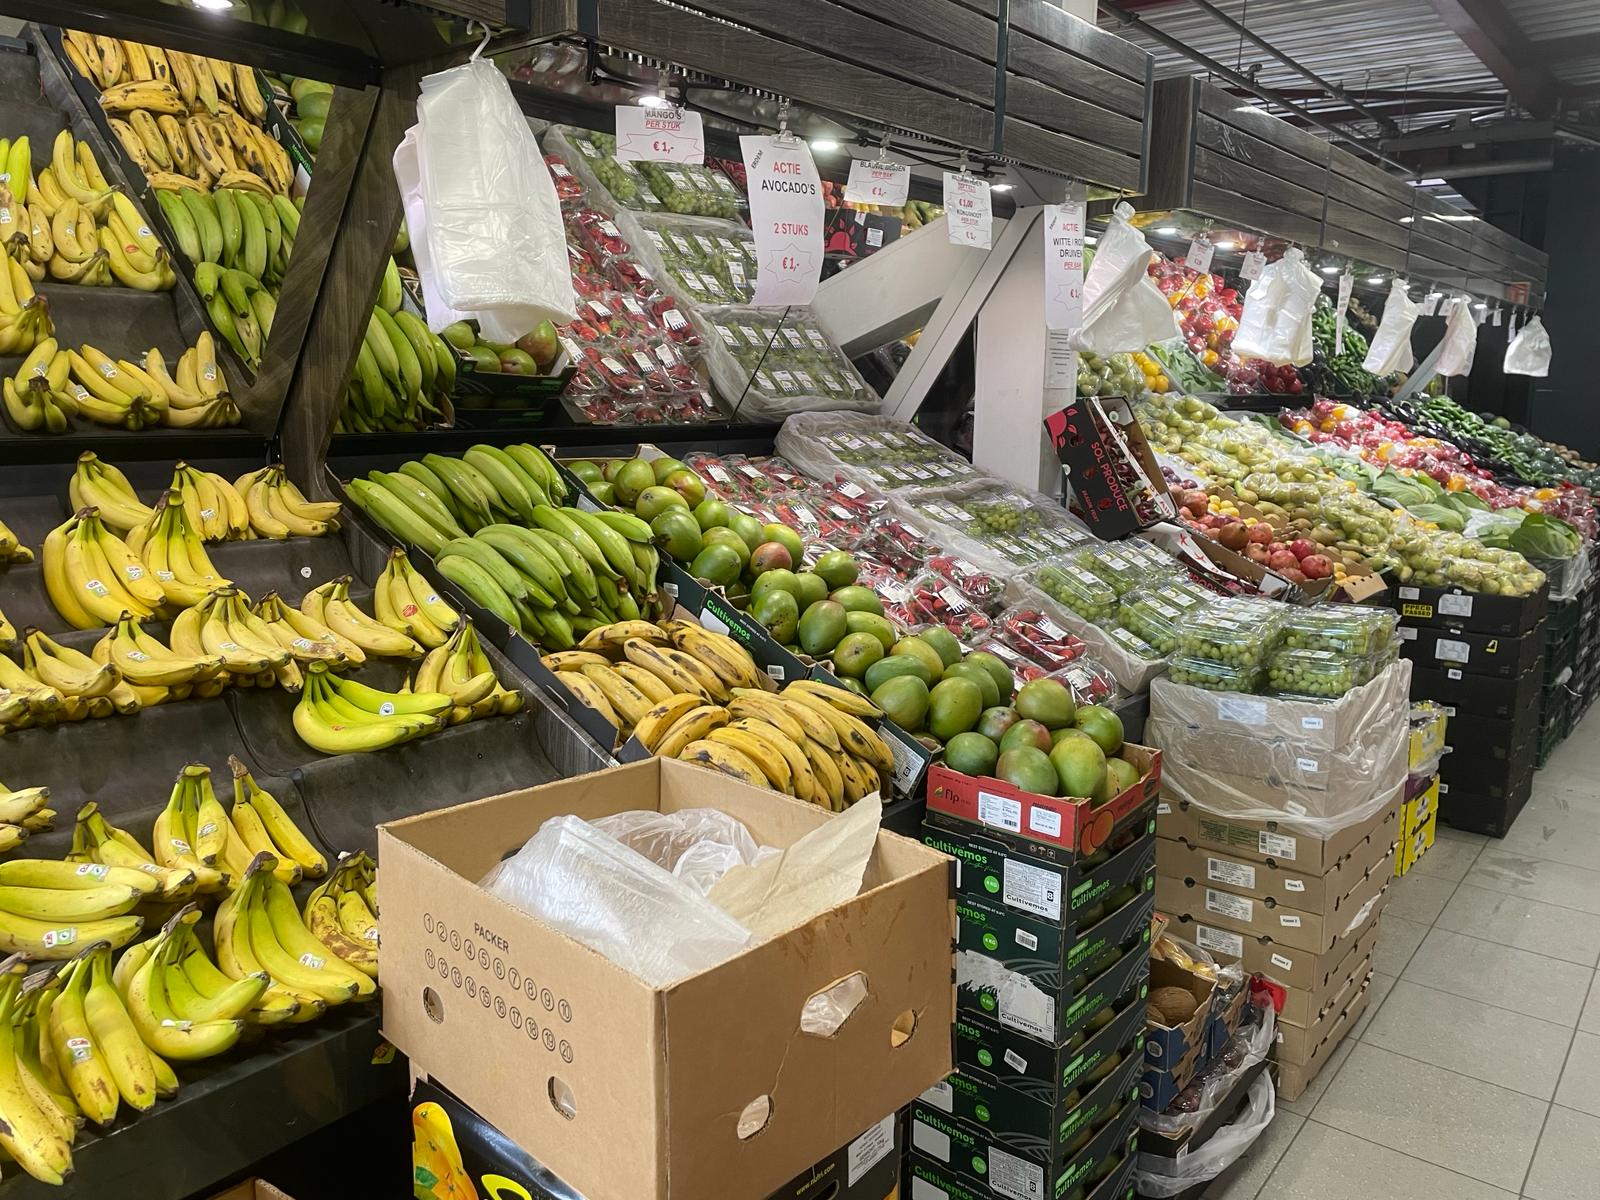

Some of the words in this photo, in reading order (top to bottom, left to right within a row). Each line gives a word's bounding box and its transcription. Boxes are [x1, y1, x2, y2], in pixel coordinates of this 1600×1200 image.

[645, 120, 660, 129] PER
[662, 121, 681, 130] STUK
[653, 141, 659, 151] €
[662, 142, 675, 154] 1,-
[751, 150, 764, 169] ERDEM
[773, 161, 801, 176] ACTIE
[761, 179, 816, 195] AVOCADO'S
[774, 223, 779, 234] 2
[781, 223, 809, 236] STUKS
[1062, 223, 1079, 231] ACTIE
[1053, 238, 1071, 247] WITTE
[782, 257, 788, 269] €
[789, 257, 800, 272] 1,-
[1091, 442, 1105, 463] SOL
[1100, 463, 1128, 512] PRODUCE
[706, 600, 751, 640] Cultivemos
[924, 836, 988, 864] Cultivemos
[1006, 894, 1049, 912] Cultivemos
[1071, 879, 1110, 910] Cultivemos
[474, 922, 510, 954] PACKER
[1067, 938, 1106, 970] Cultivemos
[1066, 992, 1104, 1028] Cultivemos
[1001, 1013, 1043, 1033] Cultivemos
[1063, 1050, 1101, 1087] Cultivemos
[915, 1109, 974, 1145] Cultivemos
[1060, 1104, 1098, 1143] Cultivemos
[1055, 1157, 1093, 1199] Cultivemos
